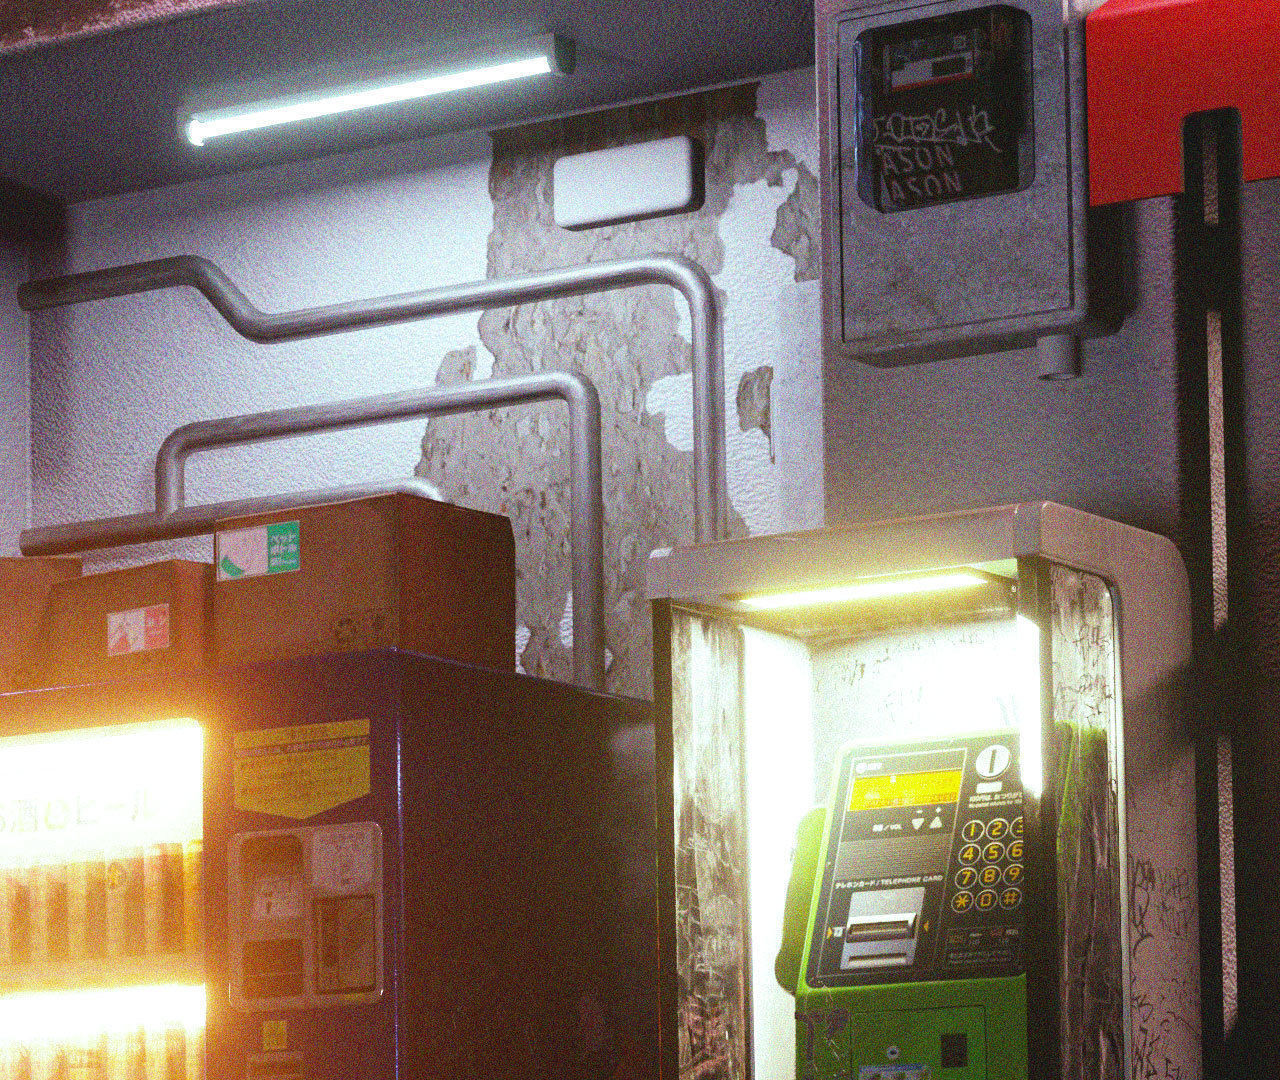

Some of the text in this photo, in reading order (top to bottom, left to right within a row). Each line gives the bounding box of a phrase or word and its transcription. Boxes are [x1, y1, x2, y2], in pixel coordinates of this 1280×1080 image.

[990, 822, 1003, 837] 2
[962, 846, 975, 861] 4
[987, 845, 1000, 860] 5
[960, 867, 1021, 885] 7 8 9
